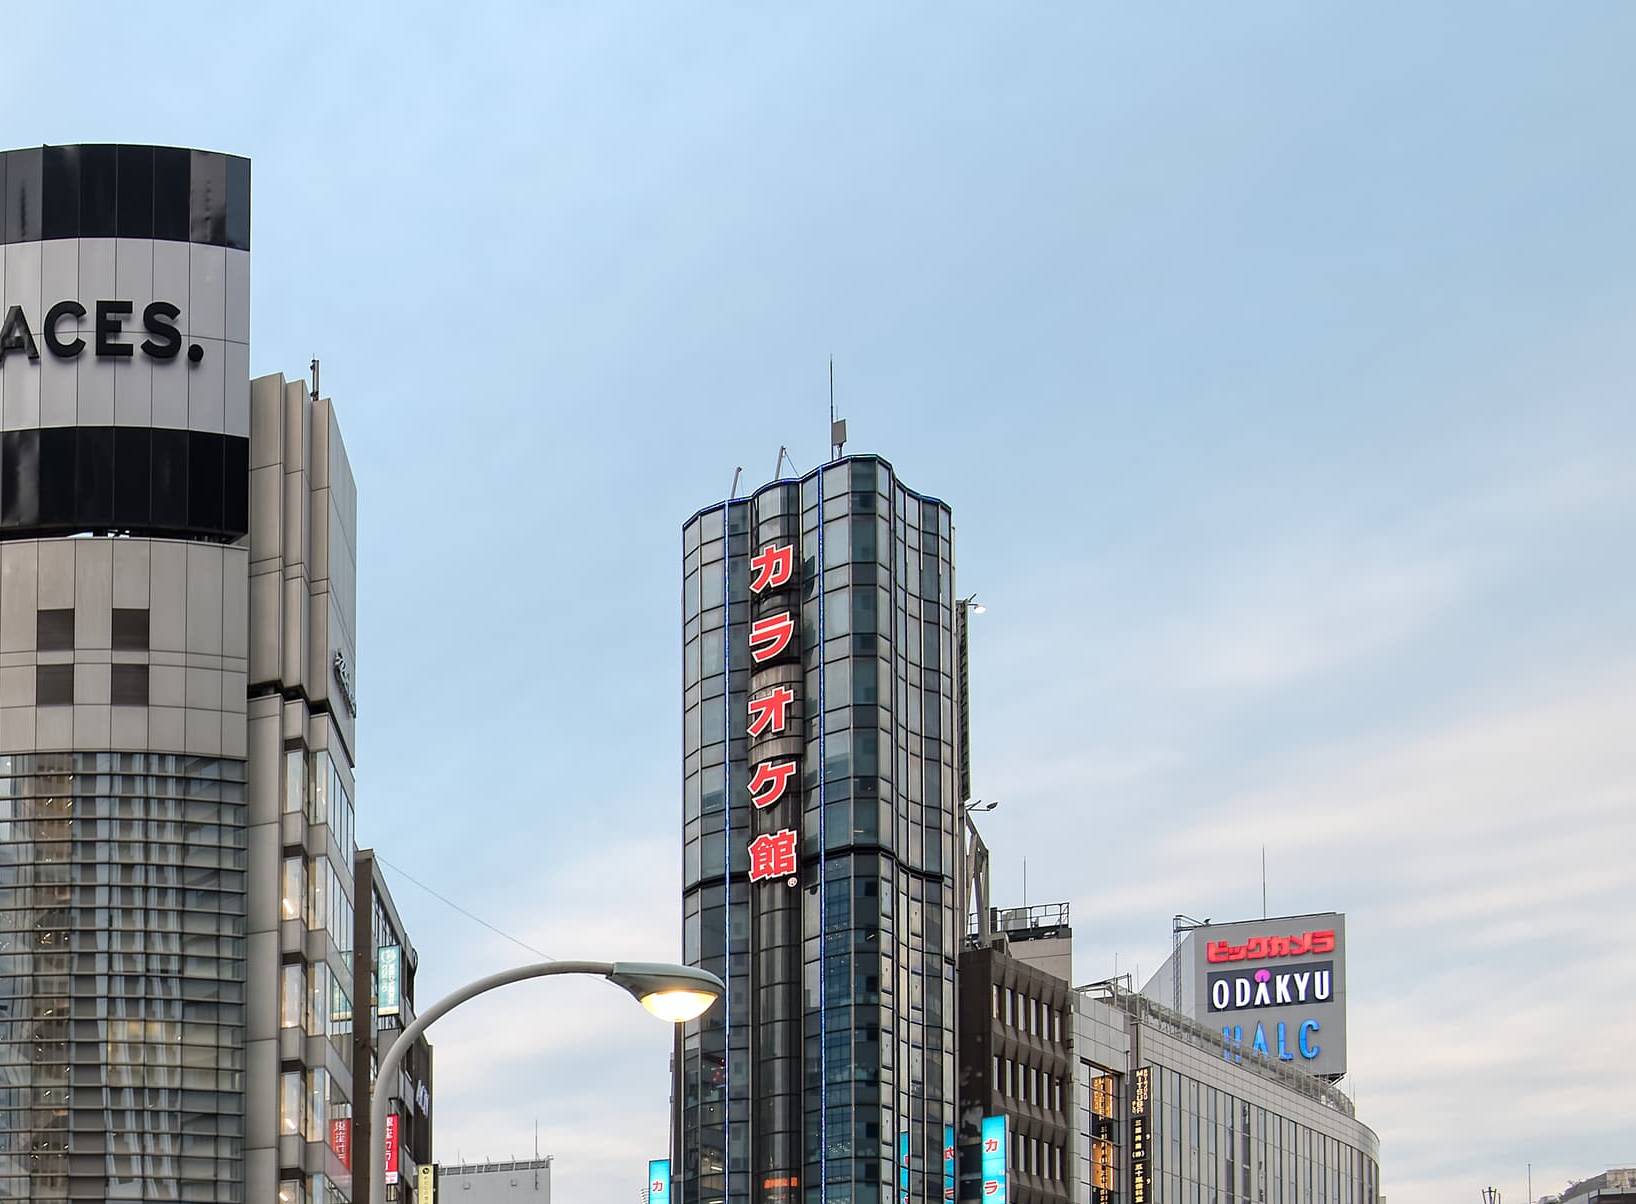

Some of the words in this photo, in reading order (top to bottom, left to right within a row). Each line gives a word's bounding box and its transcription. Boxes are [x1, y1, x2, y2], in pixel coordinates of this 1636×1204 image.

[748, 543, 798, 883] カラオケ館
[1206, 930, 1335, 963] ビックカメラ
[1212, 969, 1330, 1009] ODAKYU
[1222, 1018, 1320, 1062] HALC
